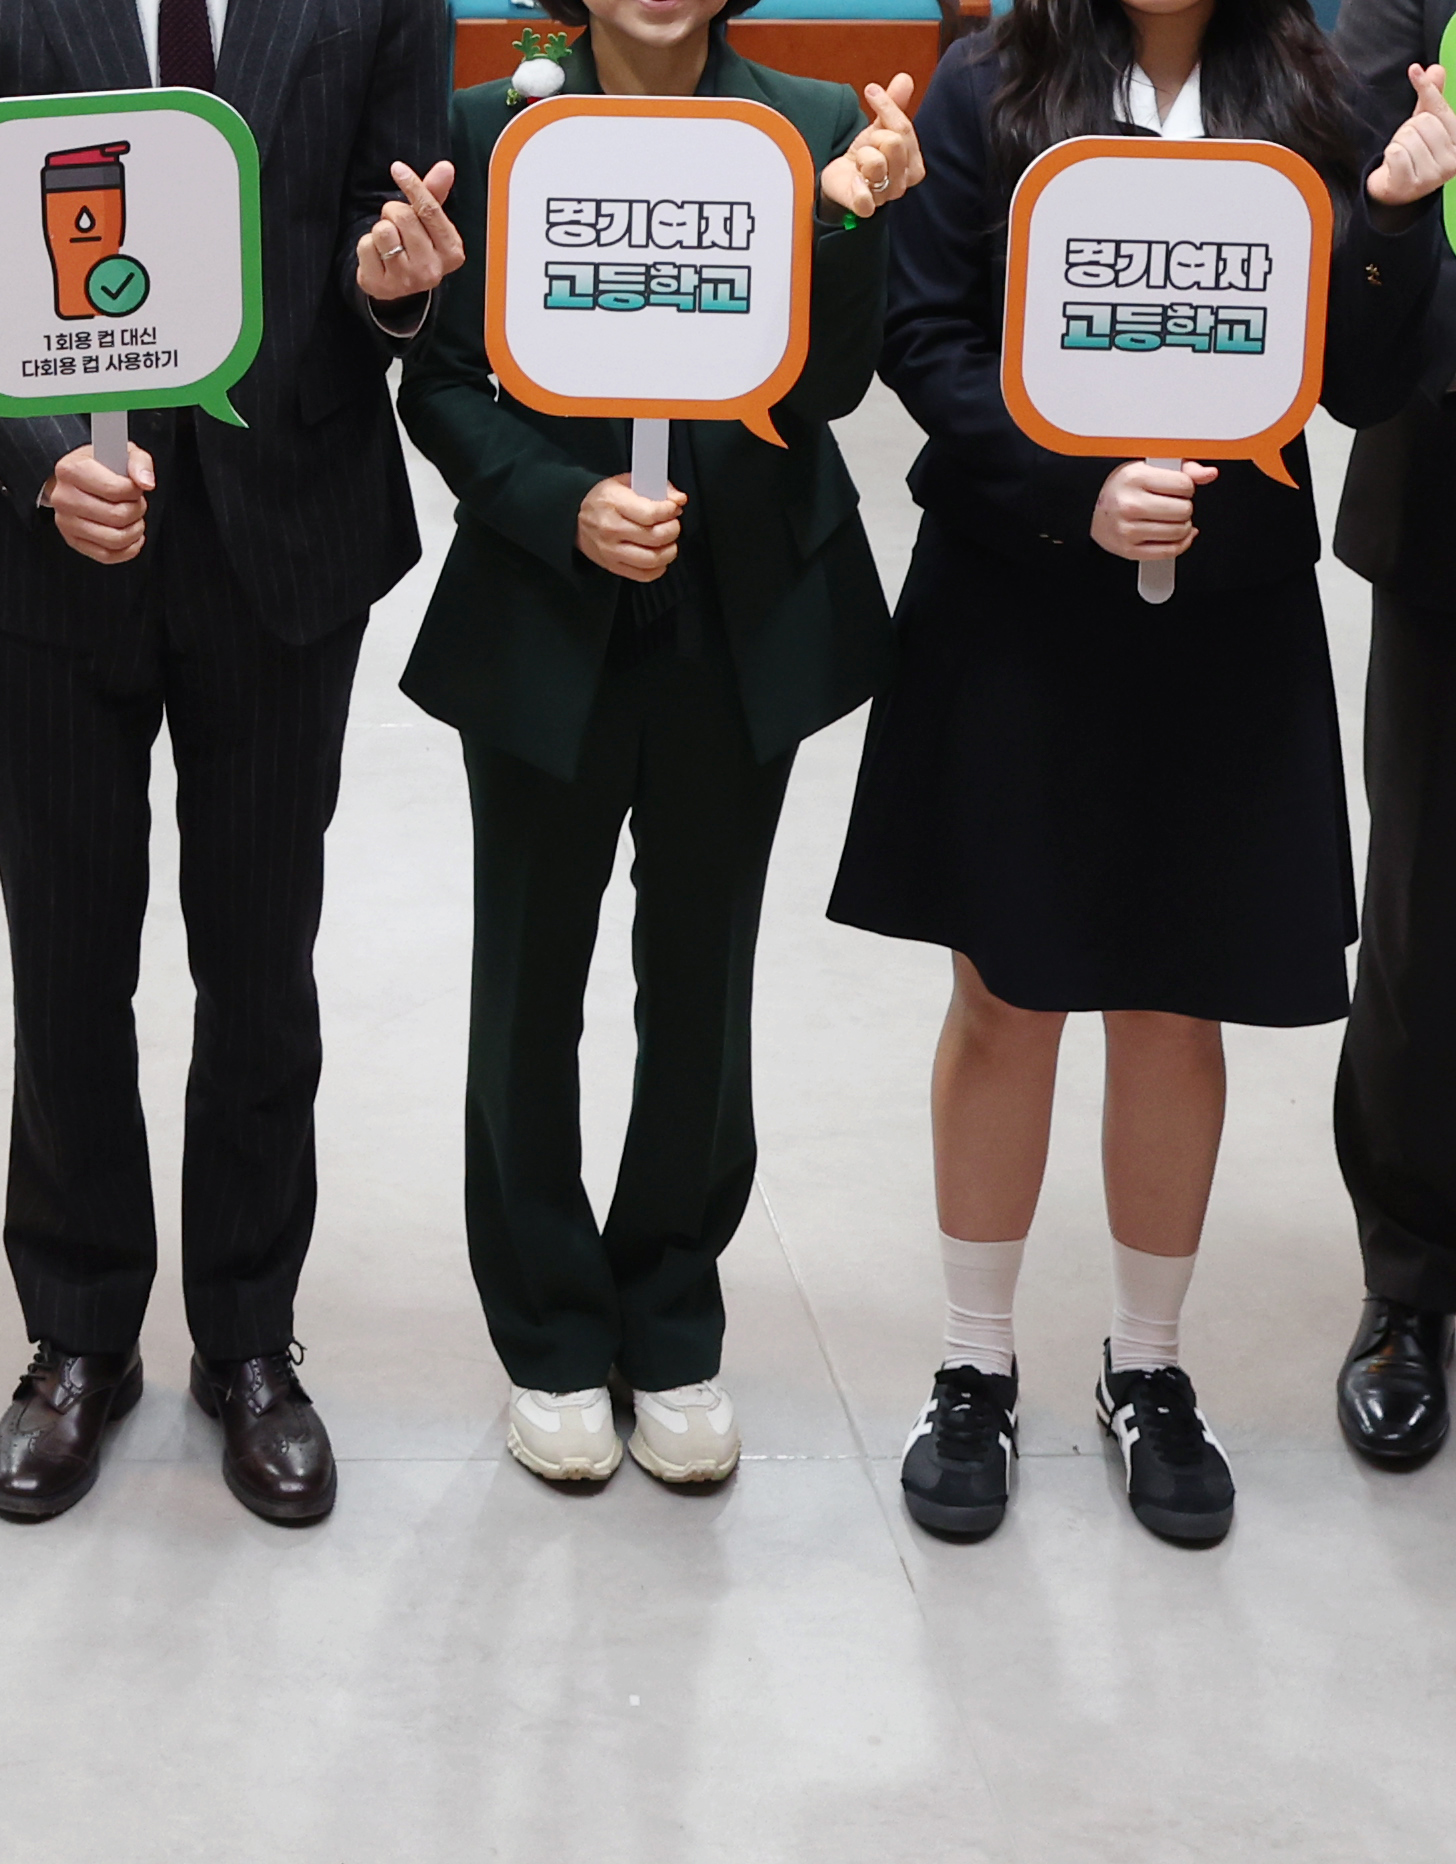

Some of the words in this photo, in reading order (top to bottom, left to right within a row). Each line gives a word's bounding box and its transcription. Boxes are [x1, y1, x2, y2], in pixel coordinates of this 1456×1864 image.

[545, 197, 755, 251] 경기여자
[543, 261, 752, 314] 고등학교
[1064, 238, 1273, 292] 경기여자
[43, 331, 92, 351] 1회용
[97, 329, 115, 348] 컵
[121, 326, 157, 347] 대신
[1060, 301, 1267, 355] 고등학교
[22, 355, 77, 378] 다회용
[82, 355, 99, 374] 컵
[105, 349, 179, 373] 사용하기
